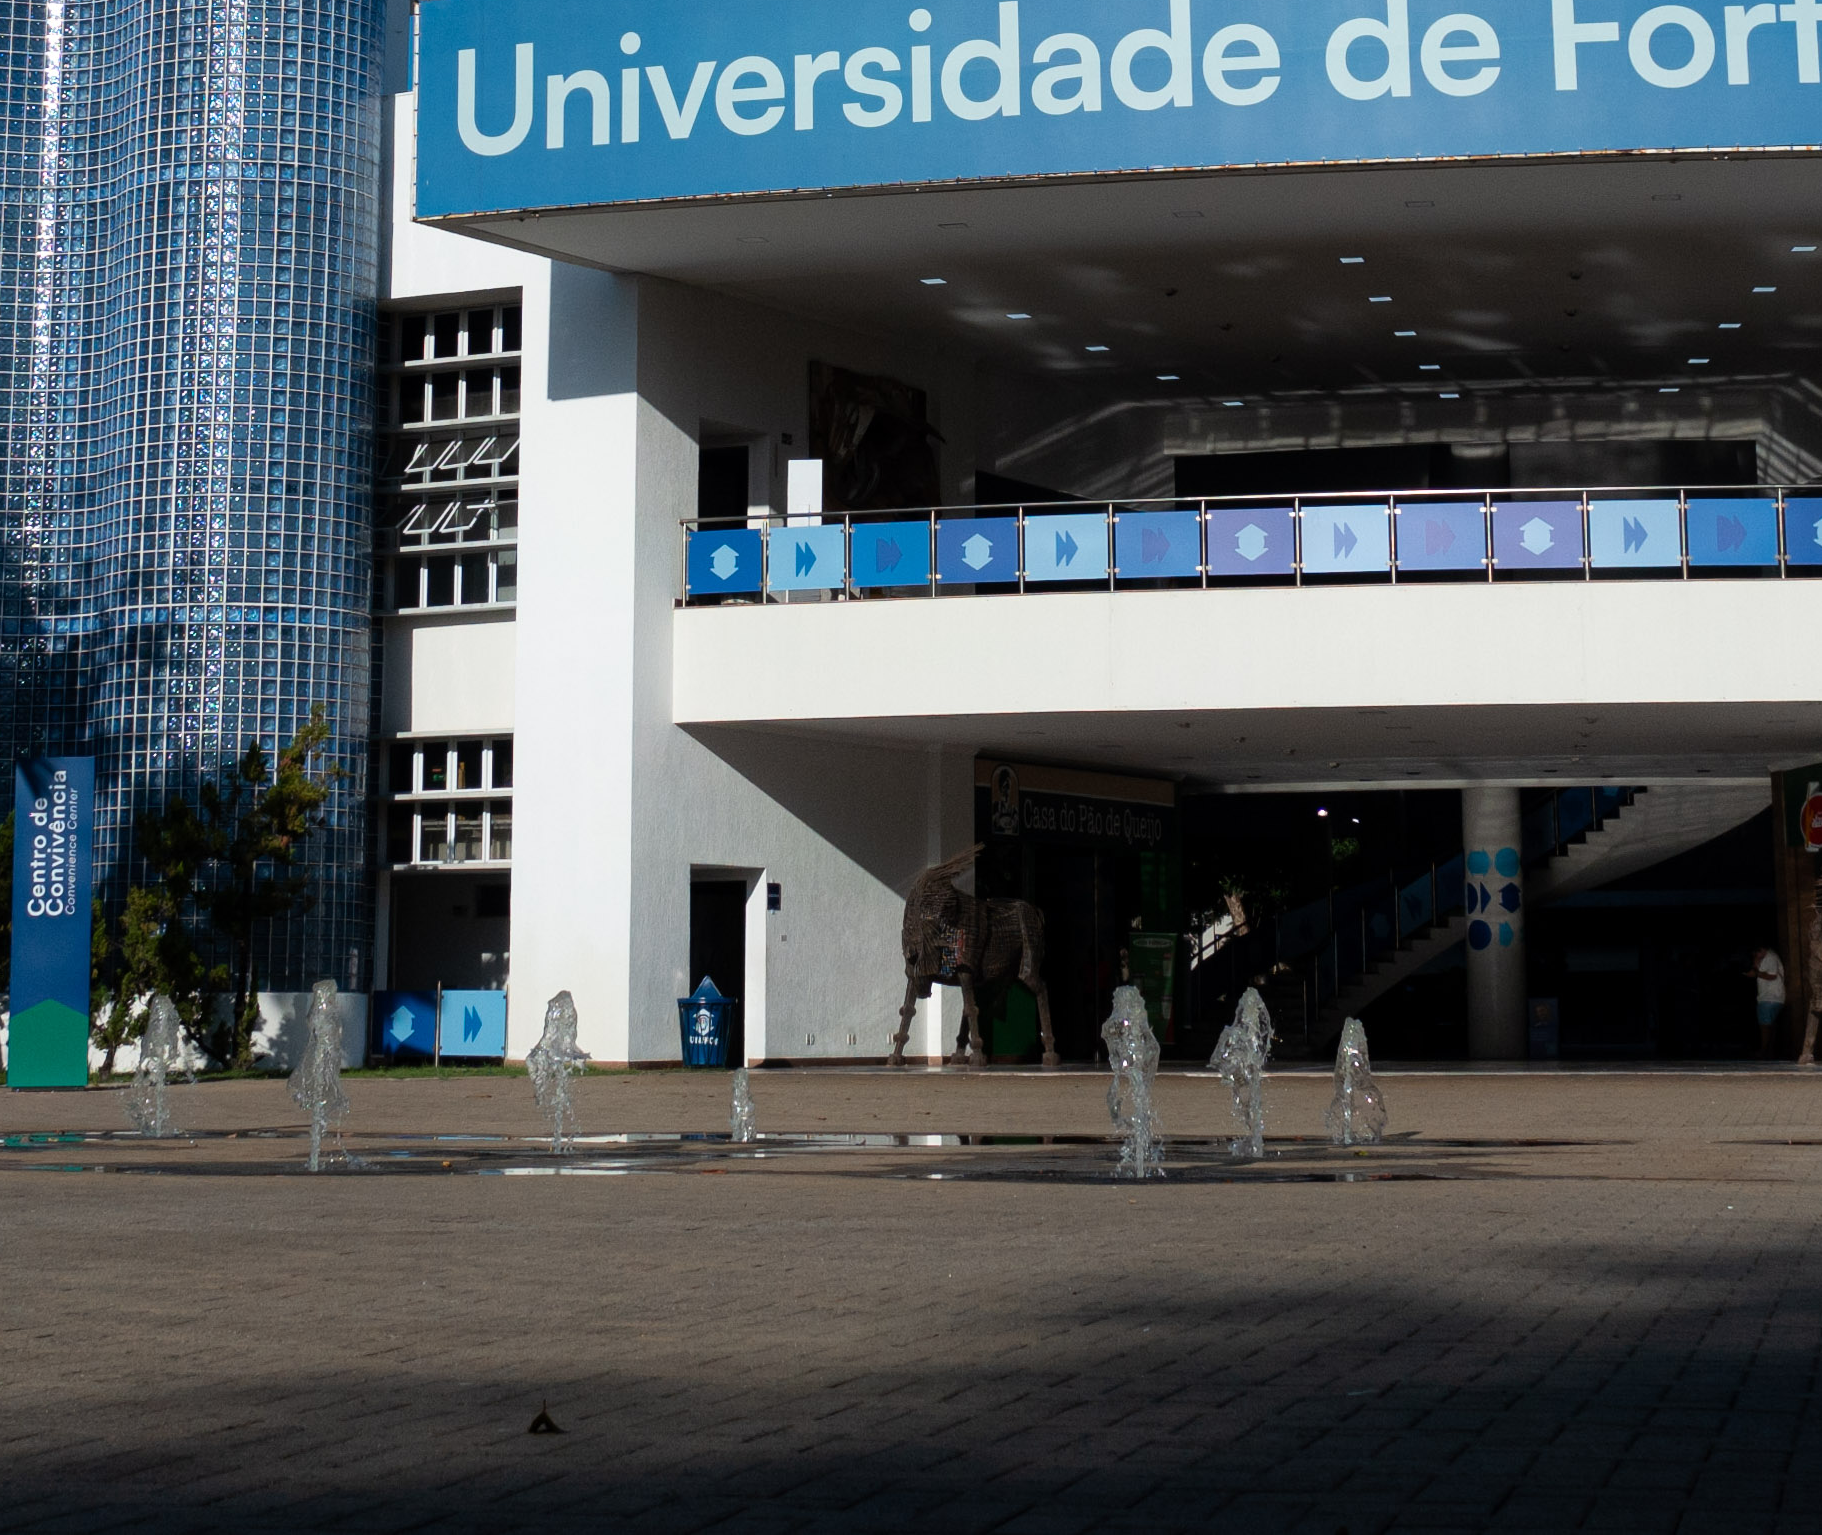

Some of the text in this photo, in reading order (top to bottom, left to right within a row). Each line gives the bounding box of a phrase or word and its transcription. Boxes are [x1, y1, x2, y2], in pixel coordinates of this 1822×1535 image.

[27, 796, 48, 917] Centro de
[46, 769, 67, 917] Convivência
[65, 787, 78, 915] Convenience Center
[1023, 798, 1162, 847] Casa do Pão de Queijo
